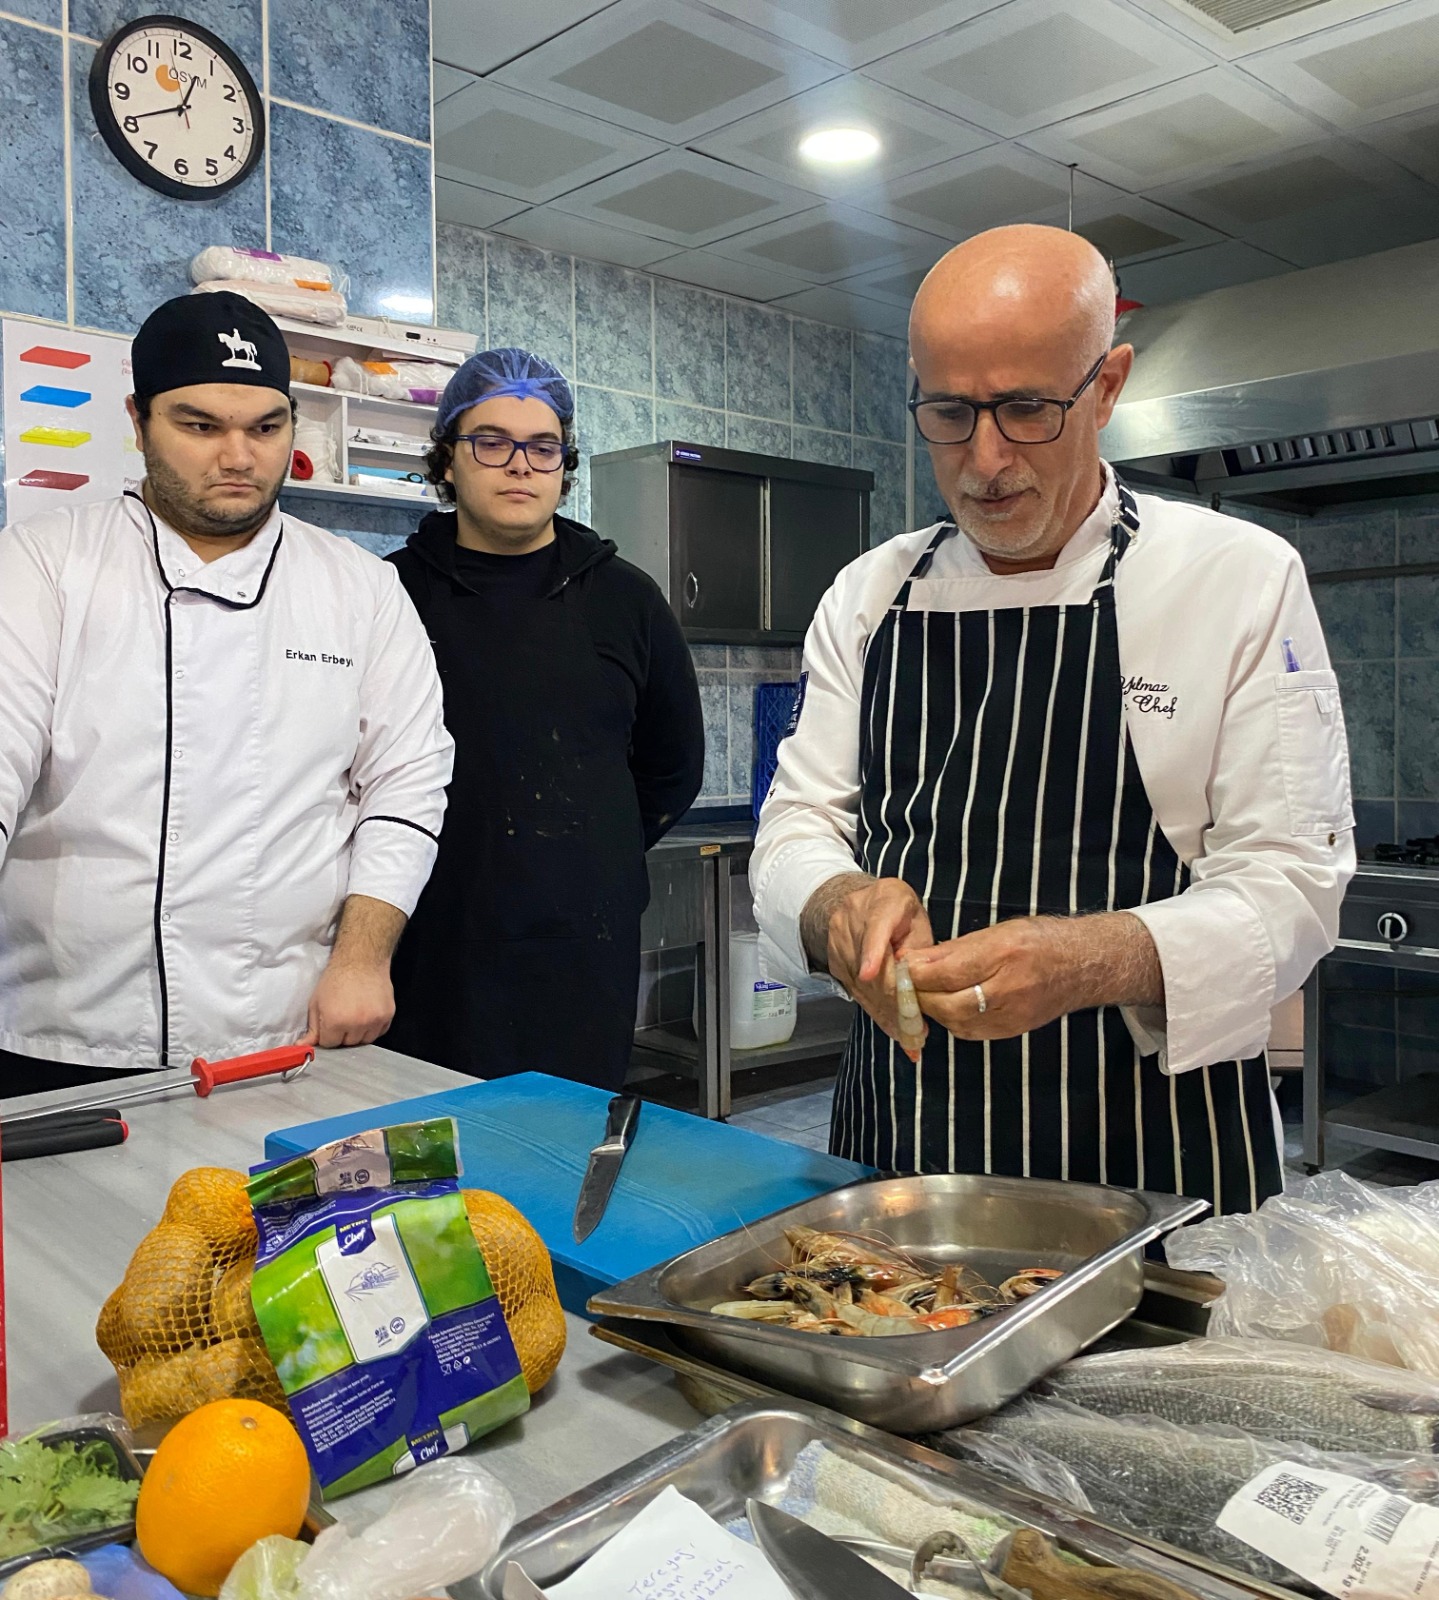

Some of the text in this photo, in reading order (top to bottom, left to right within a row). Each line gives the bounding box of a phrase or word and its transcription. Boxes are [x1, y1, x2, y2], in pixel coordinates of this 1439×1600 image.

[148, 39, 159, 58] 11
[173, 39, 192, 60] 12
[127, 53, 148, 74] 10
[209, 60, 213, 76] 1
[114, 82, 130, 100] 9
[222, 85, 236, 102] 2
[123, 115, 139, 133] 8
[232, 117, 244, 134] 3
[143, 140, 158, 159] 7
[224, 145, 236, 161] 4
[174, 158, 189, 175] 6
[206, 158, 218, 175] 5
[286, 649, 317, 661] Erkan
[1132, 694, 1178, 719] Chef
[340, 1218, 368, 1233] METRO
[410, 1429, 439, 1447] METRO
[420, 1439, 439, 1460] Chef
